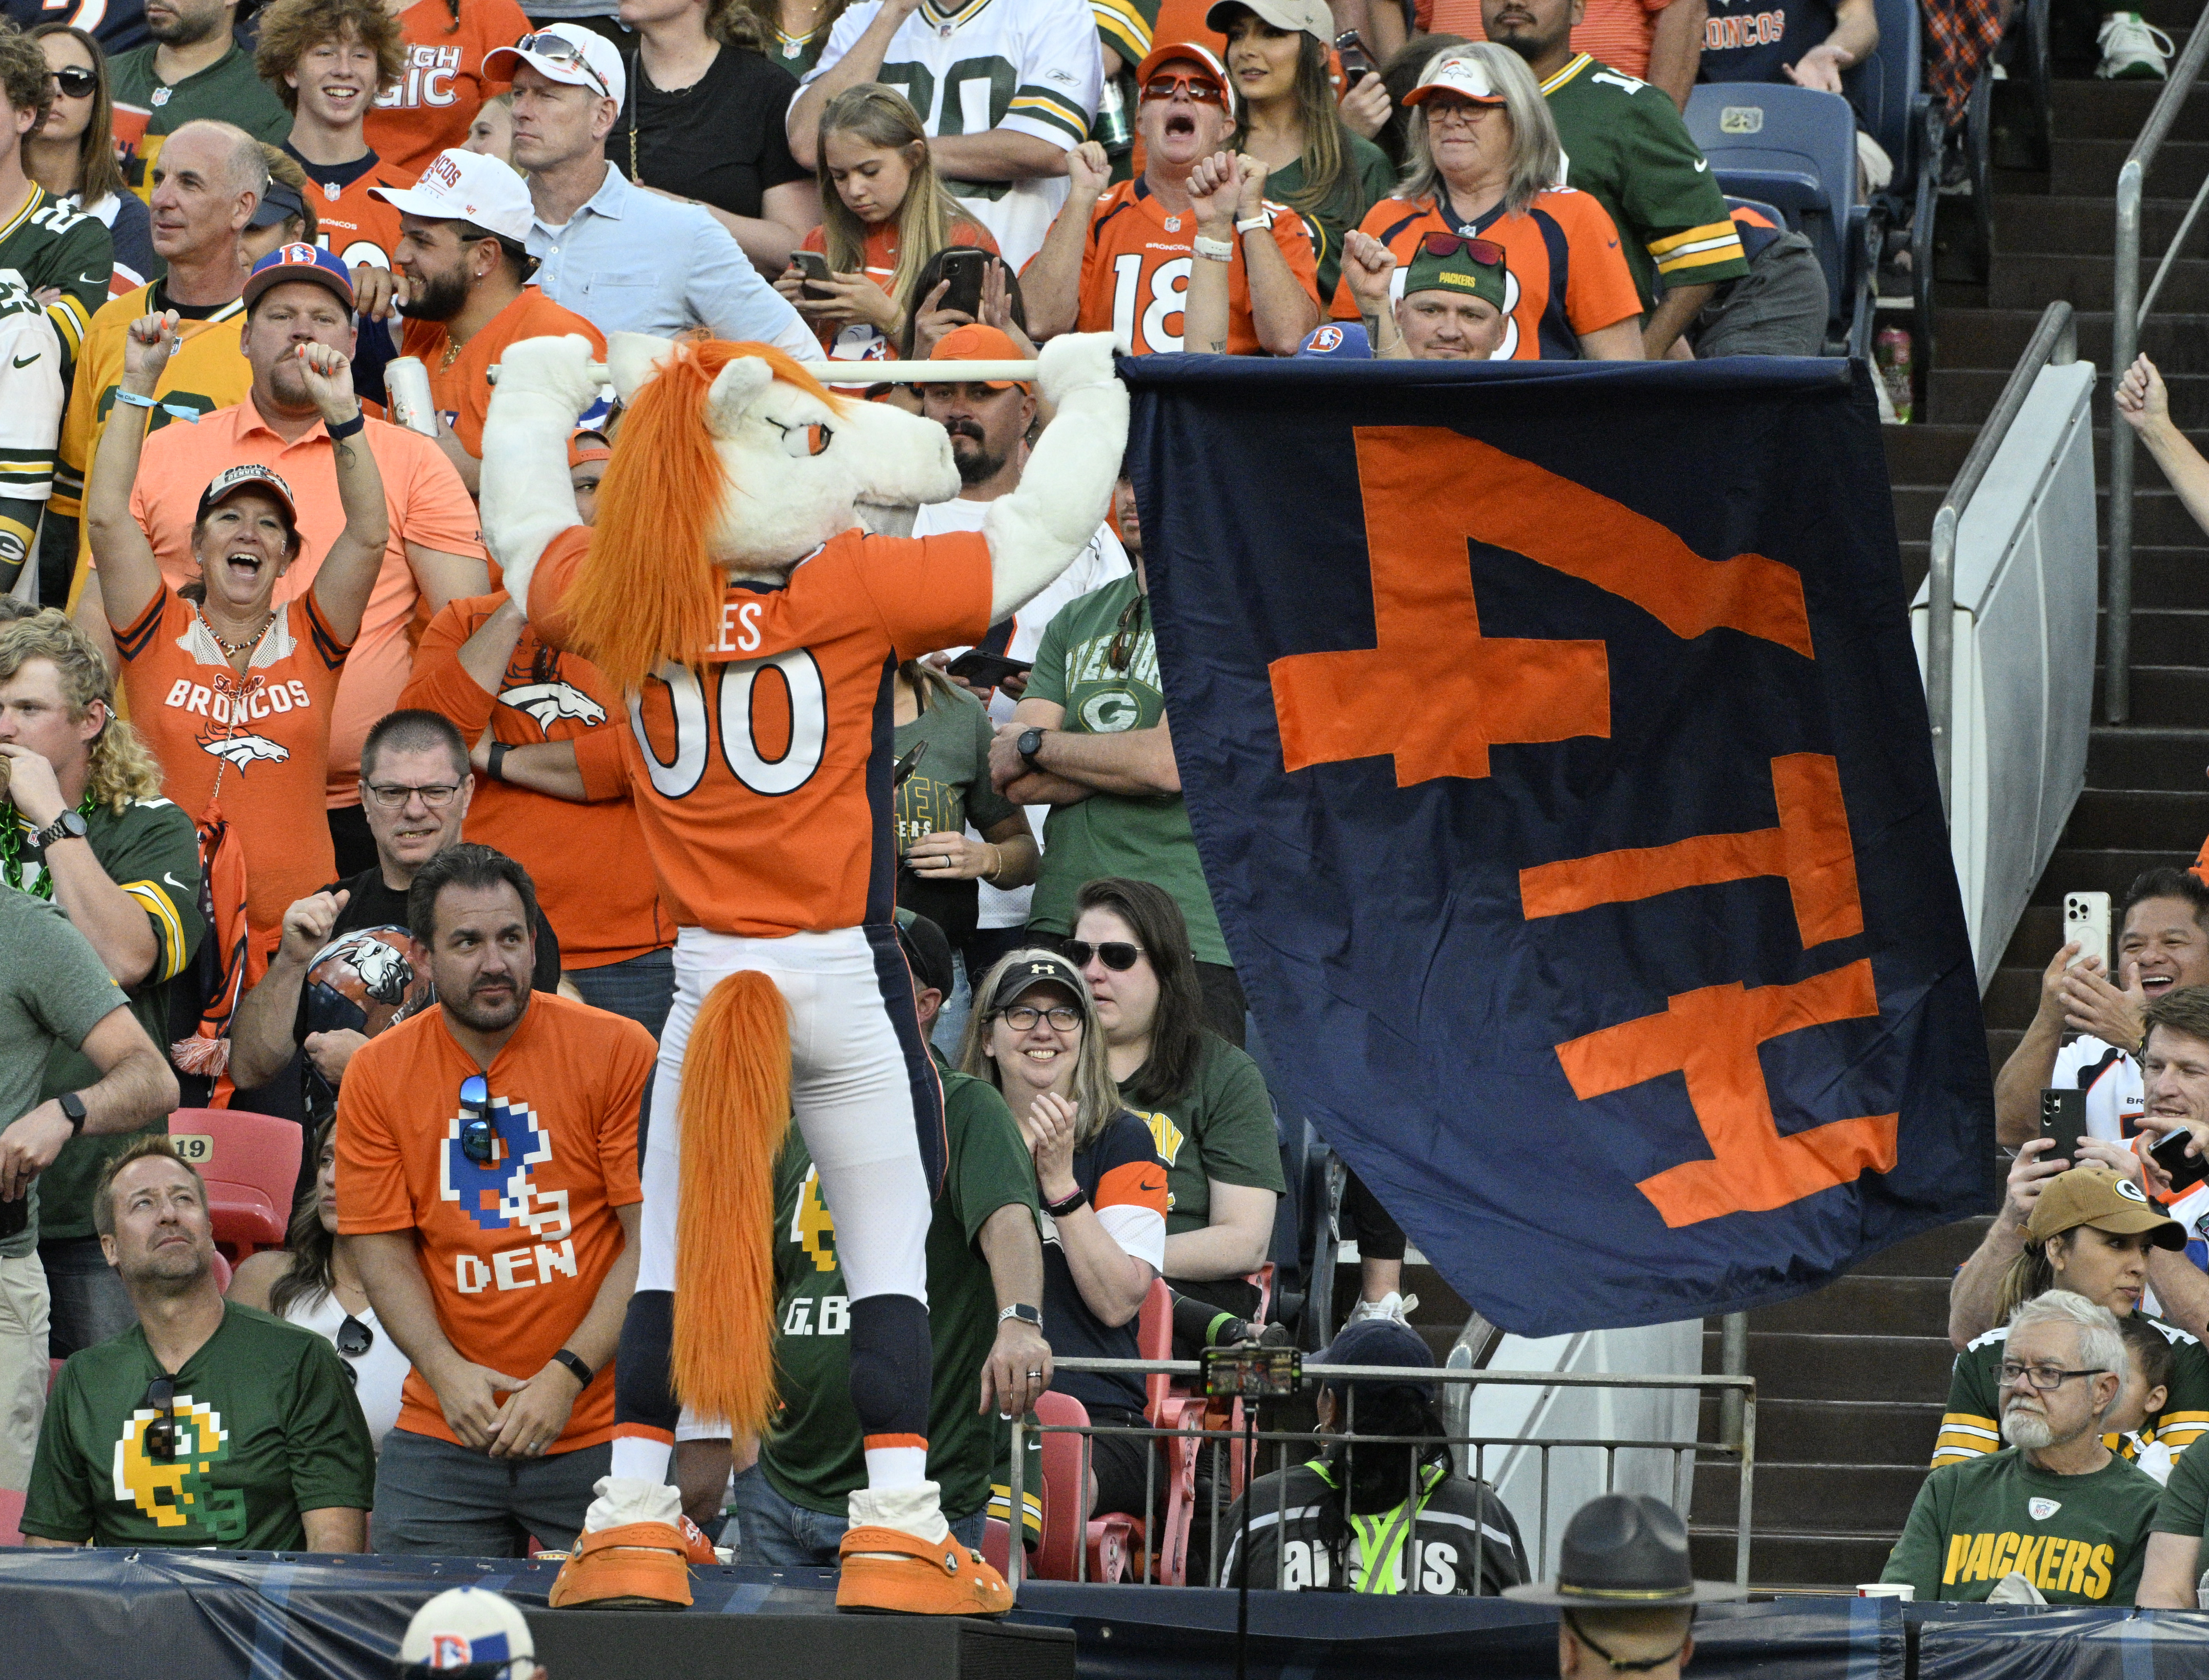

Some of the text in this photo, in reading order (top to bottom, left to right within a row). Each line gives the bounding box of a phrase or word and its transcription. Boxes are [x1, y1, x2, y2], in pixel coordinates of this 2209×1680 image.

[1702, 9, 1785, 51] ONCOS
[404, 44, 462, 68] IGH
[1591, 68, 1653, 95] 1
[433, 154, 461, 188] NCOS
[318, 218, 357, 230] RONCOS
[1146, 243, 1191, 252] BRONCOS
[1439, 272, 1475, 288] PACKERS
[228, 470, 261, 480] DENVER
[164, 679, 311, 726] BRONCOS
[1267, 425, 1899, 1228] 4TH
[176, 1140, 205, 1158] 19
[456, 1239, 578, 1293] DEN
[848, 1533, 891, 1545] crocs
[1943, 1531, 2114, 1600] PACKERS
